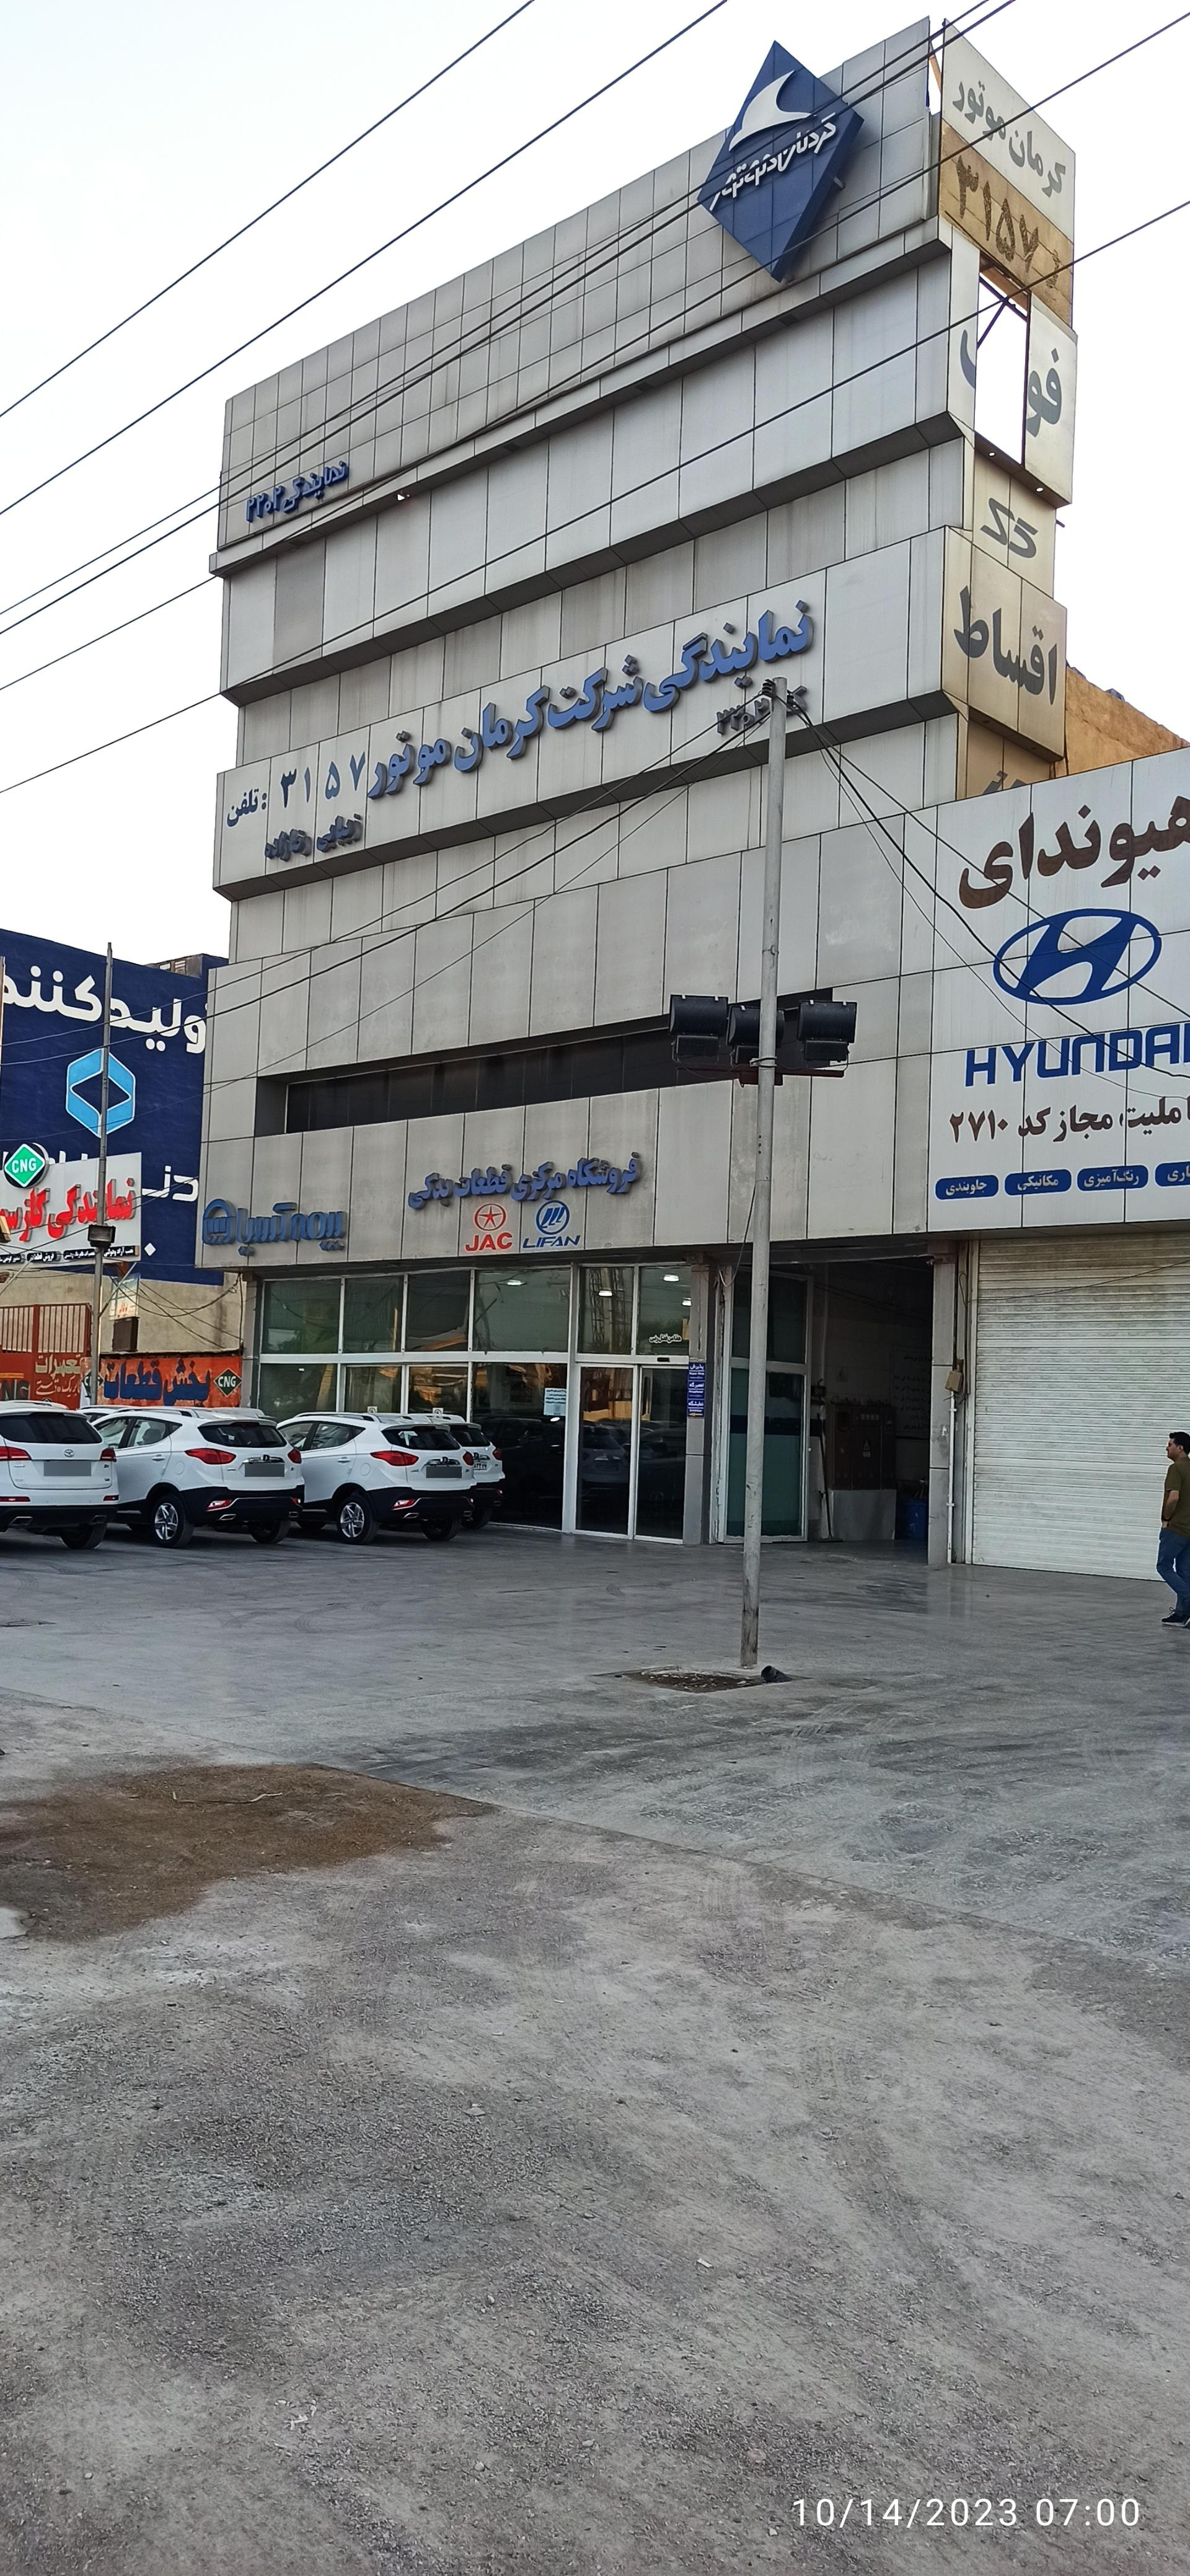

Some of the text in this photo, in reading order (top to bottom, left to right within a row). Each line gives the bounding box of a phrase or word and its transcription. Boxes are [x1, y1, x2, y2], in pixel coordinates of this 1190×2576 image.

[952, 81, 1066, 198] کرمان موتور
[956, 155, 1039, 273] ۳۱۵۷
[282, 461, 350, 515] نمایندگی
[953, 586, 1058, 705] اقساط
[367, 600, 814, 800] نمایندگی شرکت کرمان موتور
[950, 1109, 1008, 1143] ۲۷۱۰
[1018, 1107, 1051, 1137] کد
[1052, 1105, 1113, 1142] مجاز
[12, 1158, 37, 1173] CNG
[408, 1152, 641, 1211] فروشگاه مرکزی قطعات یدکی
[1017, 1175, 1059, 1191] مکانیکی
[946, 1178, 987, 1196] جلوبندی
[48, 1178, 137, 1239] نماندگی
[465, 1232, 513, 1252] JAC
[522, 1234, 581, 1249] LIFAN
[35, 1354, 81, 1380] تعمیرات
[104, 1360, 162, 1401] قطعات
[218, 1376, 236, 1387] CNG
